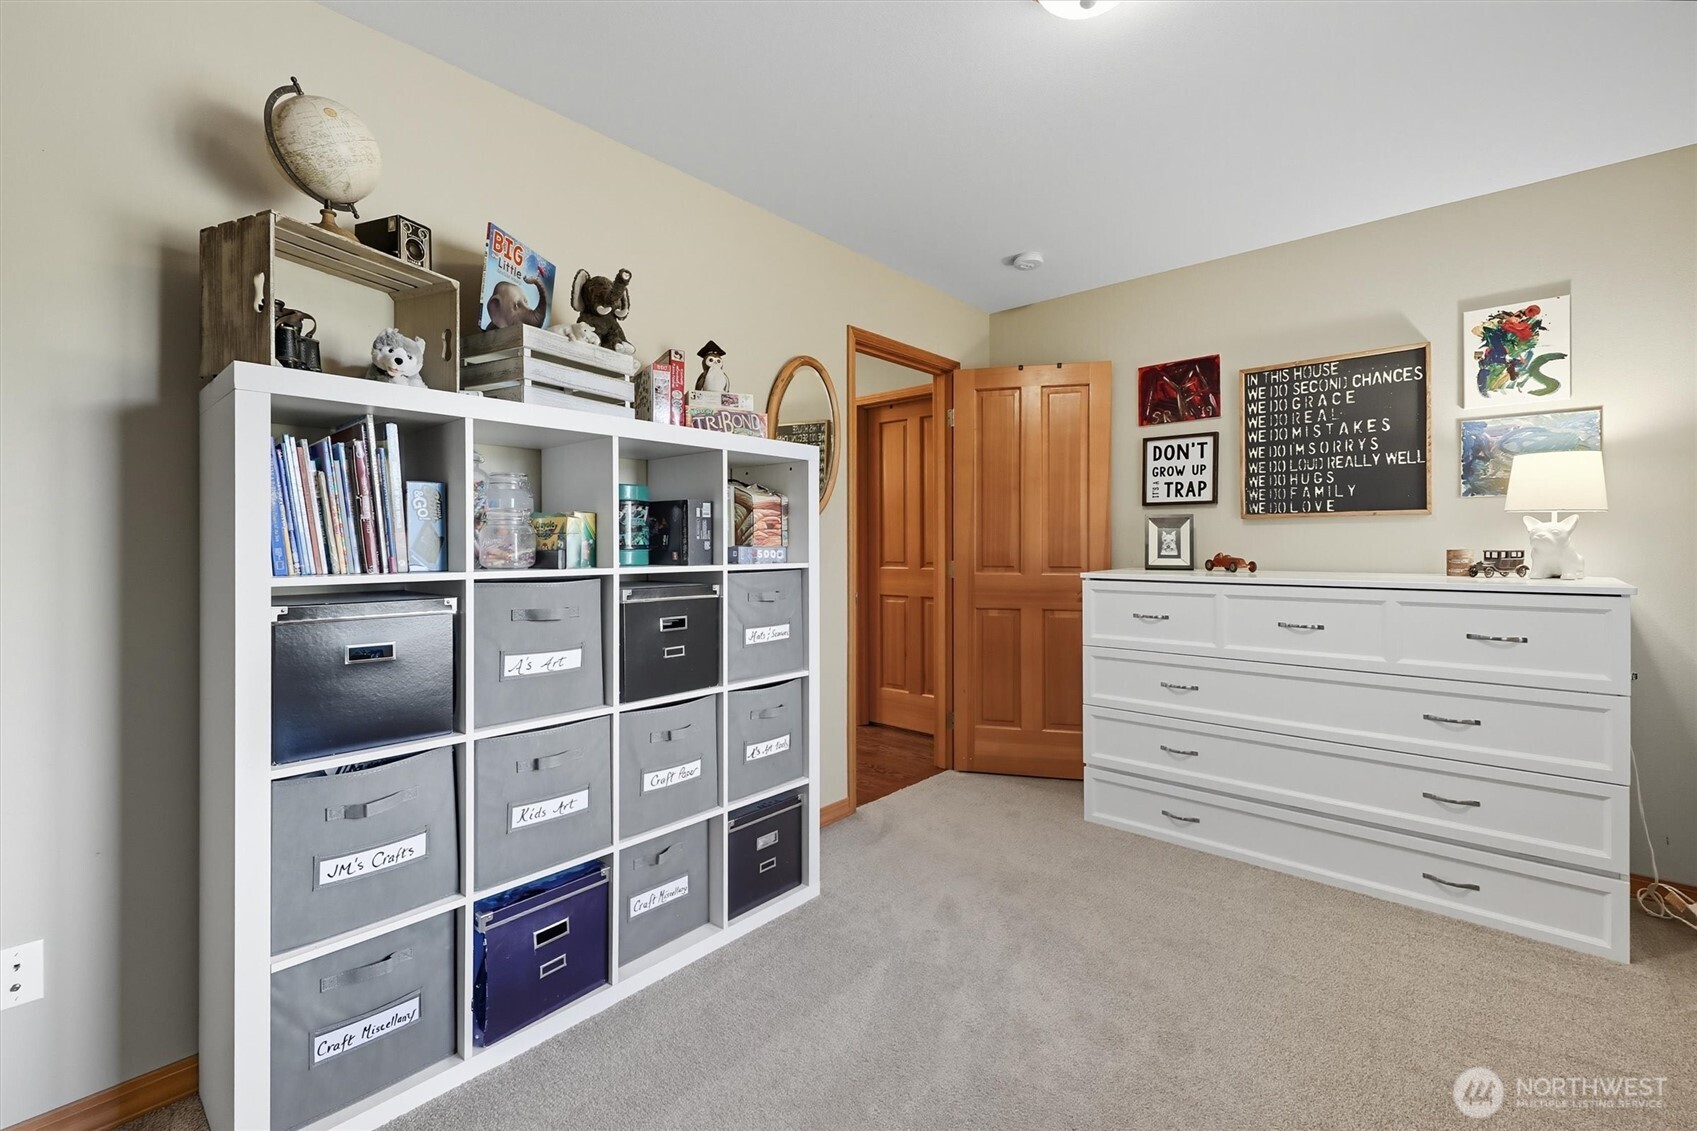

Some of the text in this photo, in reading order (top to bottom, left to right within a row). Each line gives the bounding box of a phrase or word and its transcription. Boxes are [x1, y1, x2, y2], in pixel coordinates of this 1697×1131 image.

[493, 230, 523, 266] BIG
[498, 257, 522, 279] Little
[1247, 362, 1339, 386] IN THIS HOUSE
[1248, 366, 1423, 400] WE DO SECOND CHANCES
[1248, 390, 1355, 415] WE DO GRACE
[1248, 408, 1340, 428] WE DO REAL
[1248, 417, 1391, 443] WE DO MISTAKES
[1153, 442, 1208, 461] DON'T
[1248, 446, 1266, 458] WE
[1269, 445, 1286, 458] DO
[1248, 449, 1425, 473] WE DO LOUD REALLY WELL
[1152, 464, 1207, 477] GROW UP
[1249, 471, 1334, 488] WE DO HUGS
[1164, 481, 1207, 498] TRAP
[1249, 484, 1356, 500] WE DO FAMILY
[1249, 500, 1335, 513] WE DO LOVE
[540, 656, 567, 672] Art
[650, 766, 698, 787] Craft Paper
[516, 799, 578, 823] Kids Art
[327, 847, 415, 878] JM's Crafts
[633, 893, 657, 912] Craft
[317, 1008, 417, 1057] Craft Miscellany
